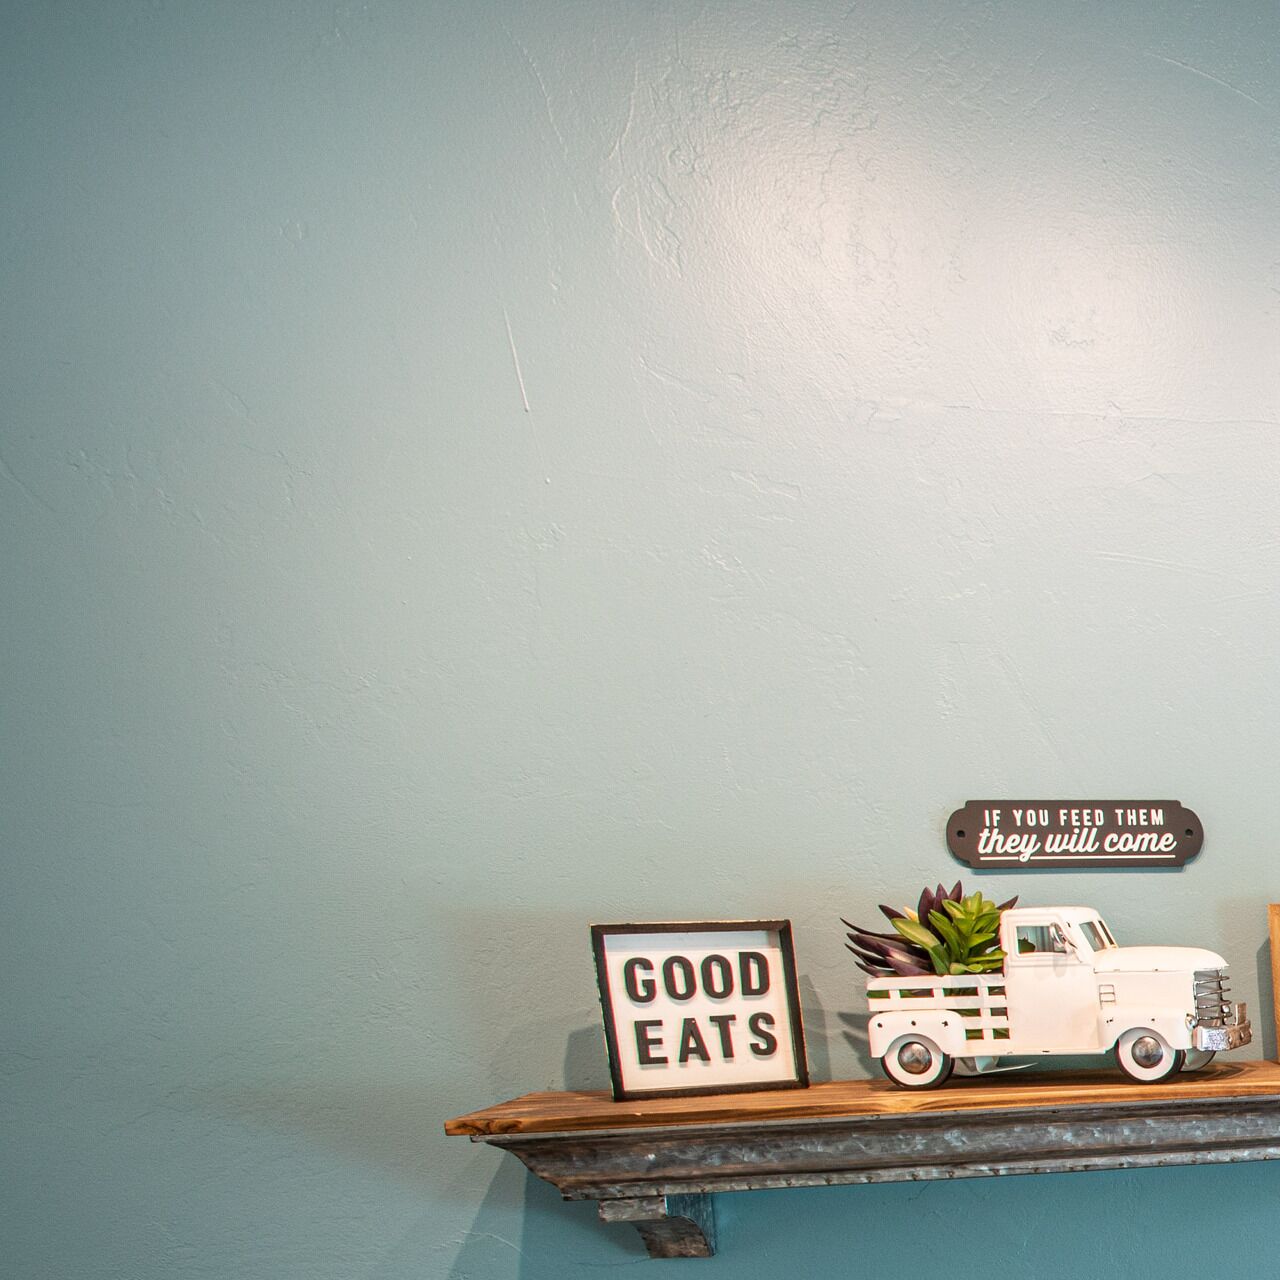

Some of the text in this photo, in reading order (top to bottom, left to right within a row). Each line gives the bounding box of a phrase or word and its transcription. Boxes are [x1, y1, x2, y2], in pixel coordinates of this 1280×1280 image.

[984, 808, 1164, 827] IF YOU FEED THEM
[977, 827, 1177, 863] they will come
[624, 951, 771, 1003] GOOD
[634, 1012, 778, 1066] EATS
